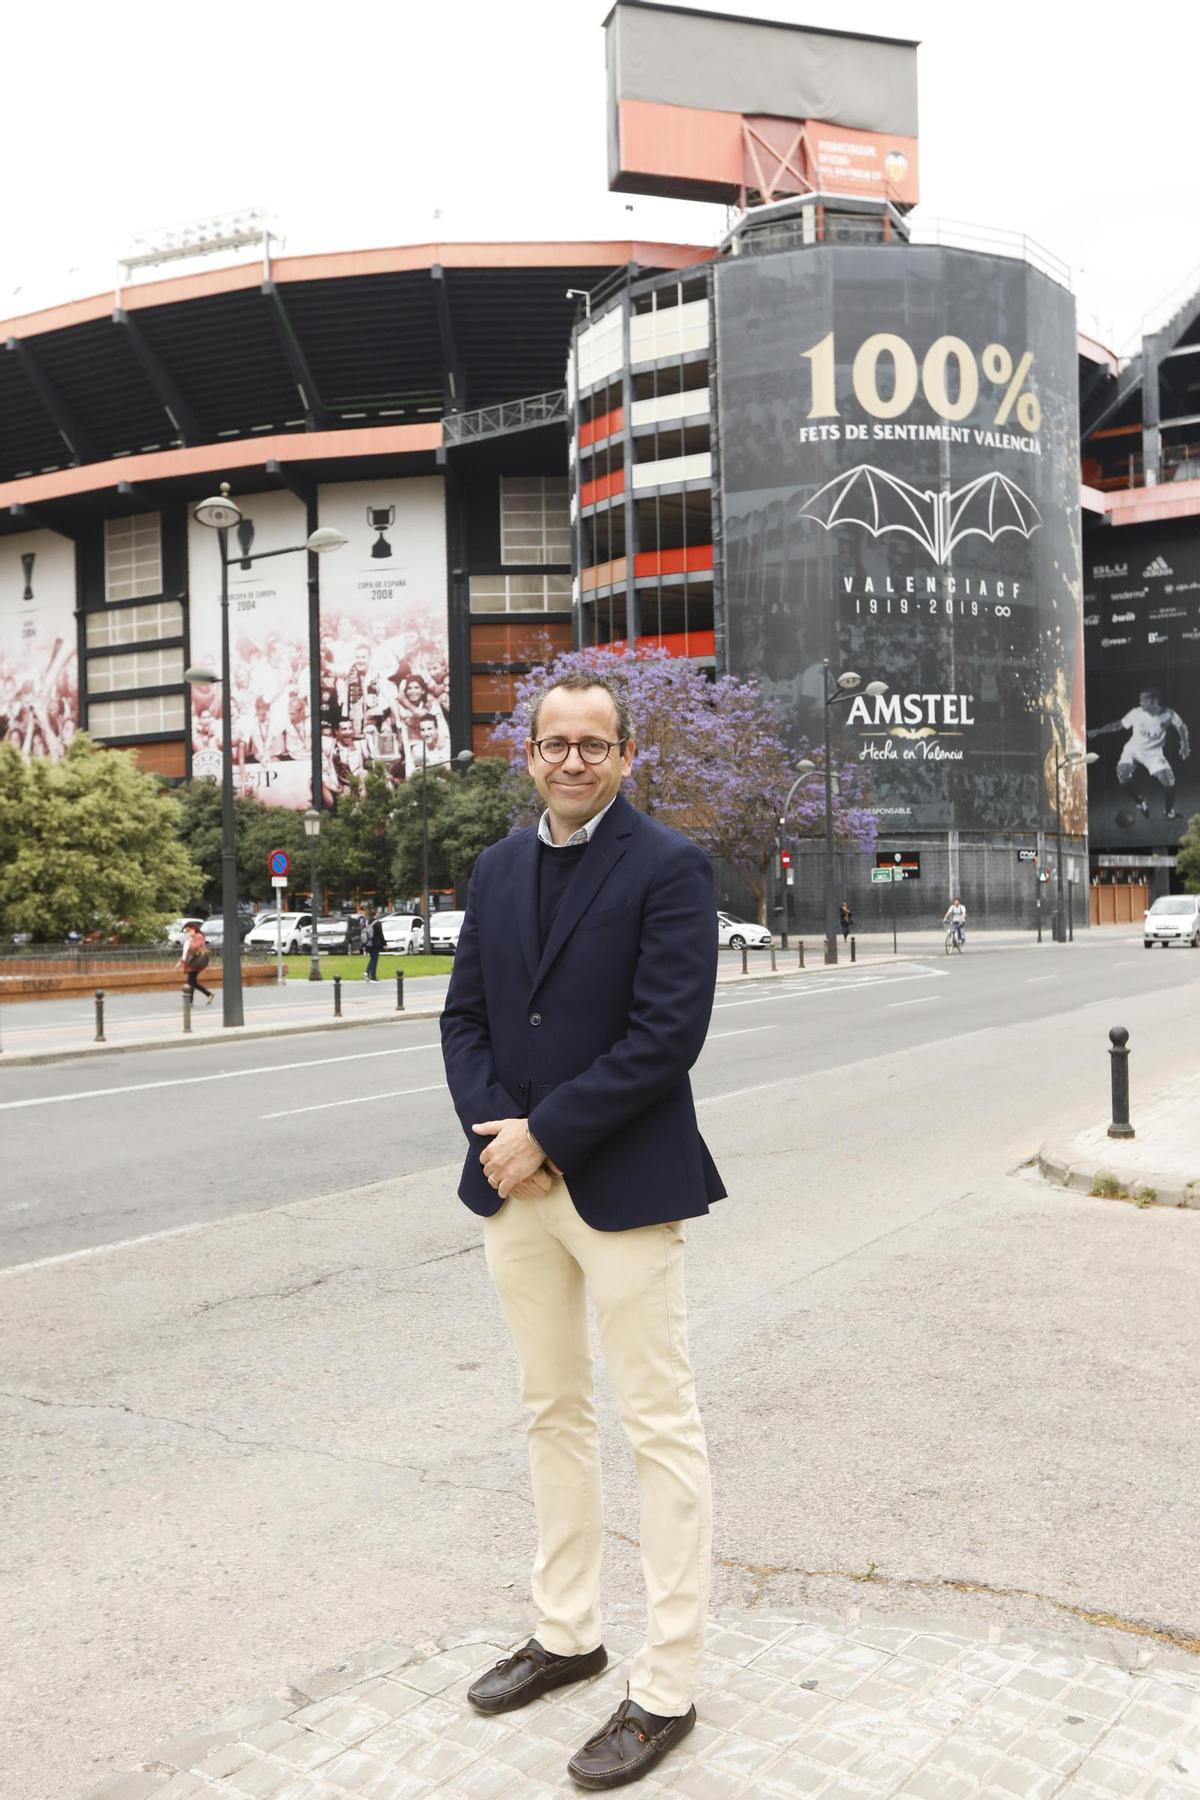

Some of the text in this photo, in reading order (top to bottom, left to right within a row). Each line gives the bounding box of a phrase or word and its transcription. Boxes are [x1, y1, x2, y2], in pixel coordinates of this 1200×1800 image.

[800, 331, 1042, 433] 100%
[800, 425, 1042, 456] FETS DE SENTIMENT VALENCIA
[236, 601, 257, 612] 2004
[371, 589, 393, 601] 2008
[846, 694, 975, 725] AMSTEL
[859, 740, 963, 760] Hecha en Valencia
